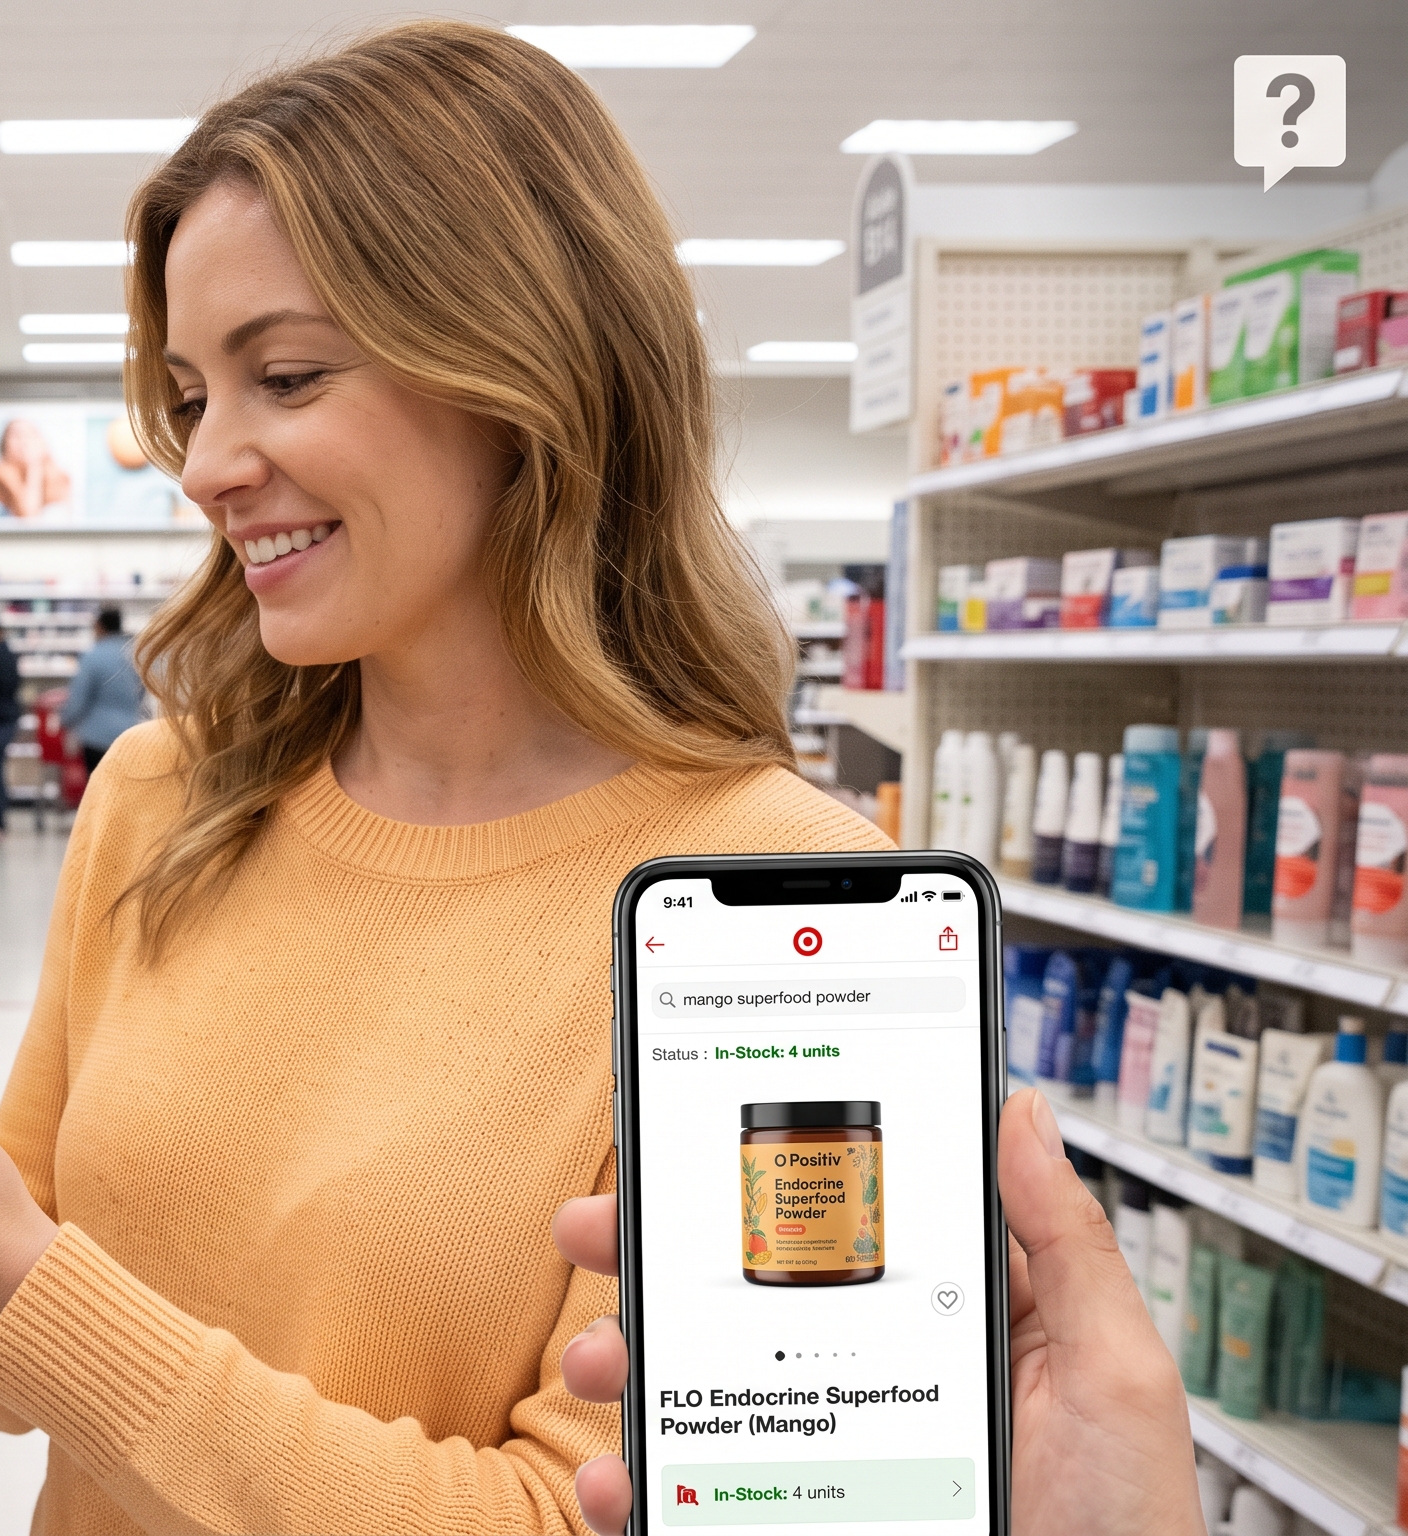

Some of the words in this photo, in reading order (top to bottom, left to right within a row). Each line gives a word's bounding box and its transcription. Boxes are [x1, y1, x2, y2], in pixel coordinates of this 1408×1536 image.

[663, 896, 693, 908] 9:41
[683, 994, 733, 1008] mango
[737, 991, 811, 1007] superfood
[816, 990, 871, 1006] powder
[652, 1048, 699, 1061] Status
[715, 1045, 785, 1060] In-Stock:
[788, 1045, 798, 1058] 4
[802, 1044, 841, 1058] units
[774, 1154, 787, 1167] O
[789, 1152, 841, 1167] Positiv
[775, 1178, 844, 1190] Endocrine
[775, 1192, 846, 1207] Superfood
[775, 1207, 827, 1219] Powder
[660, 1389, 703, 1408] FLO
[710, 1388, 820, 1407] Endocrine
[826, 1384, 940, 1408] Superfood
[660, 1417, 743, 1435] Powder
[749, 1412, 837, 1437] (Mango)
[714, 1487, 788, 1502] In-Stock:
[792, 1486, 803, 1499] 4
[808, 1485, 846, 1500] units
